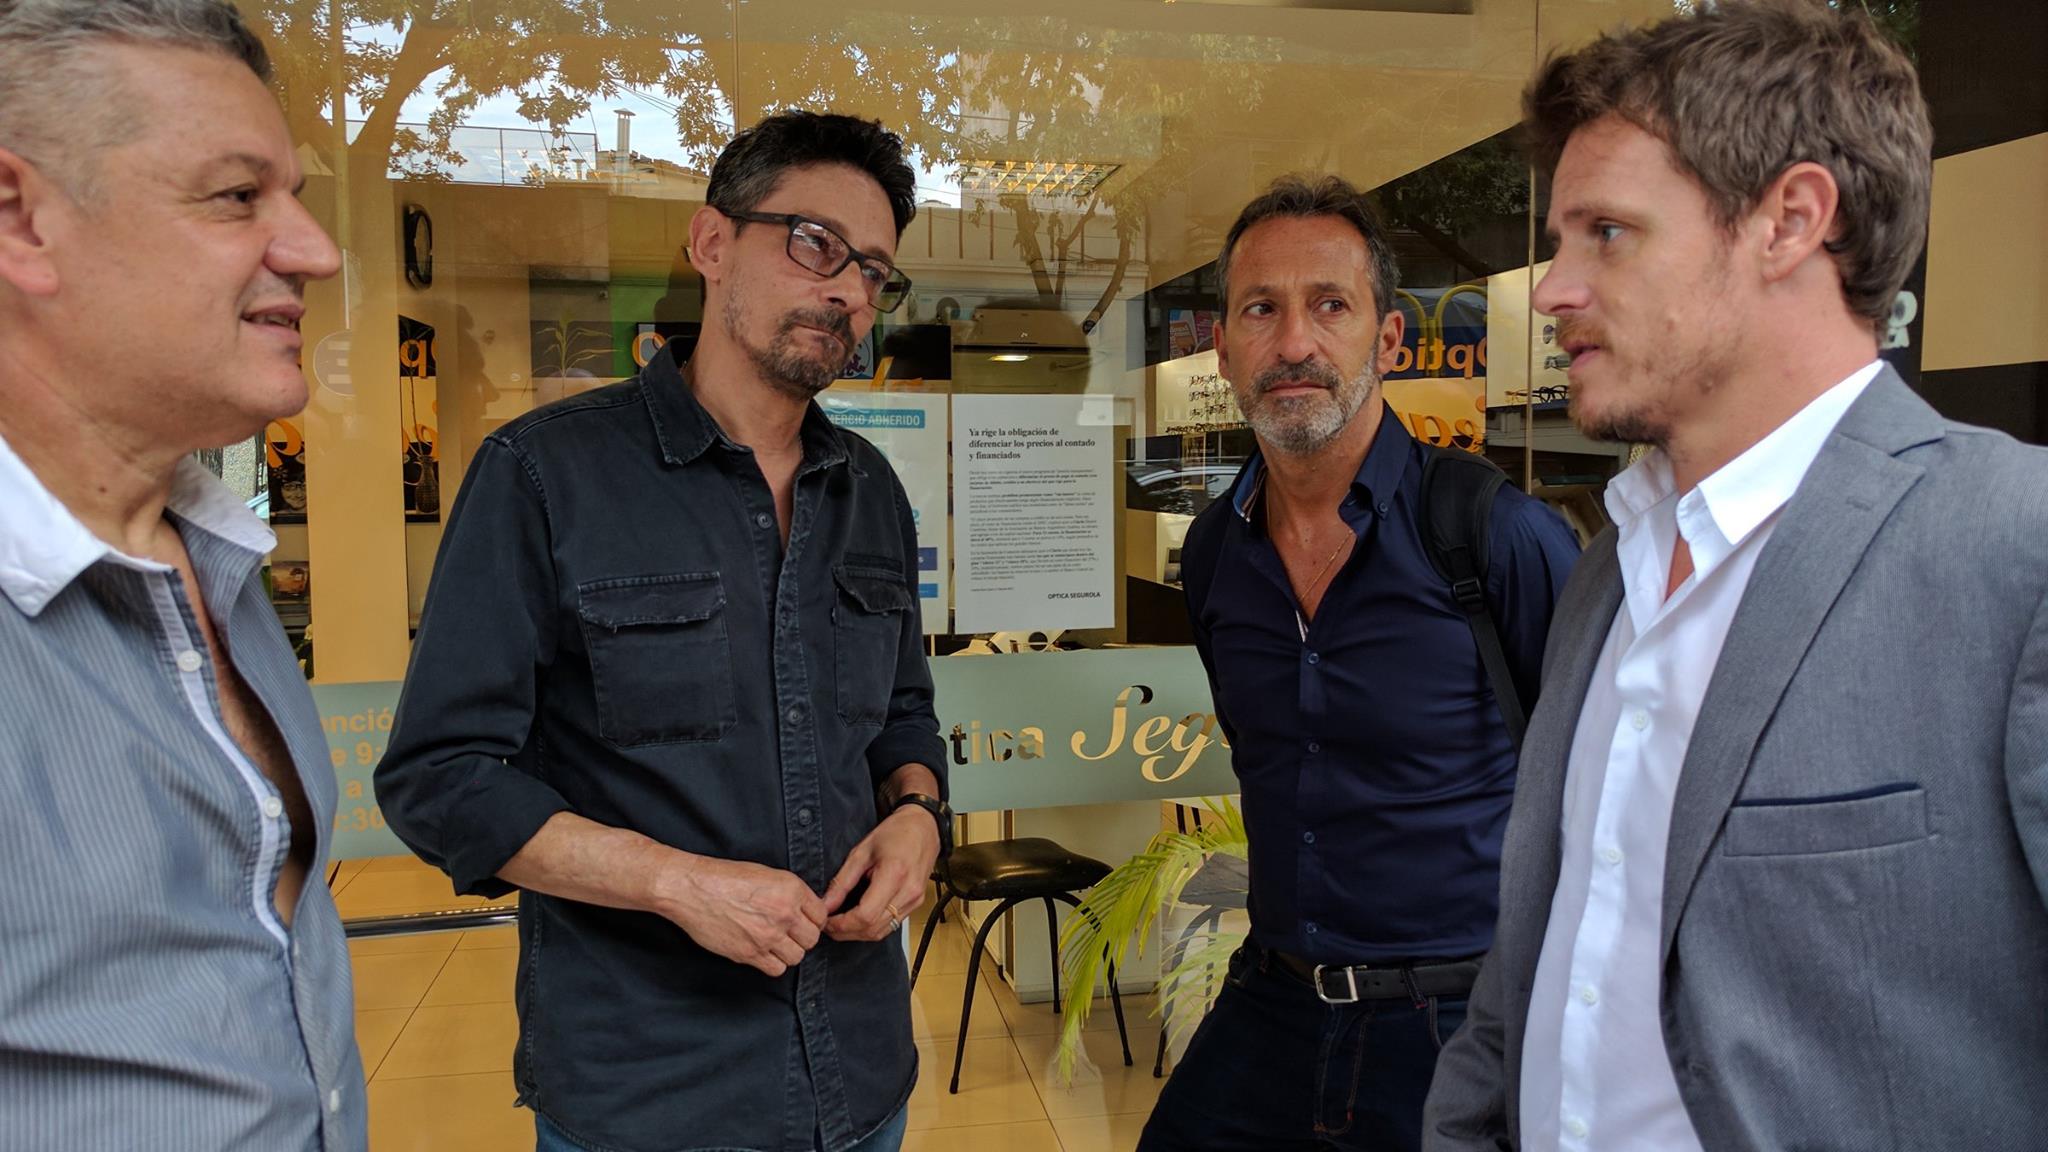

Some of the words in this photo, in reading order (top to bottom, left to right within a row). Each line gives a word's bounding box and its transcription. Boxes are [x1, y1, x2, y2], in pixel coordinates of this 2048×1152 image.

[868, 415, 921, 426] ADHERIDO
[969, 428, 979, 437] Ya
[981, 428, 997, 438] rige
[998, 428, 1006, 436] la
[1007, 427, 1048, 438] obligación
[1049, 427, 1060, 436] de
[968, 439, 1013, 449] diferenciar
[1013, 439, 1025, 448] los
[1026, 439, 1054, 449] precios
[1055, 438, 1063, 447] al
[1064, 438, 1096, 447] contado
[968, 452, 974, 462] y
[975, 450, 1021, 460] financiados
[1047, 592, 1069, 600] OPTICA
[1069, 591, 1102, 599] SEGUROLA
[949, 720, 1046, 766] tica
[345, 778, 363, 800] a
